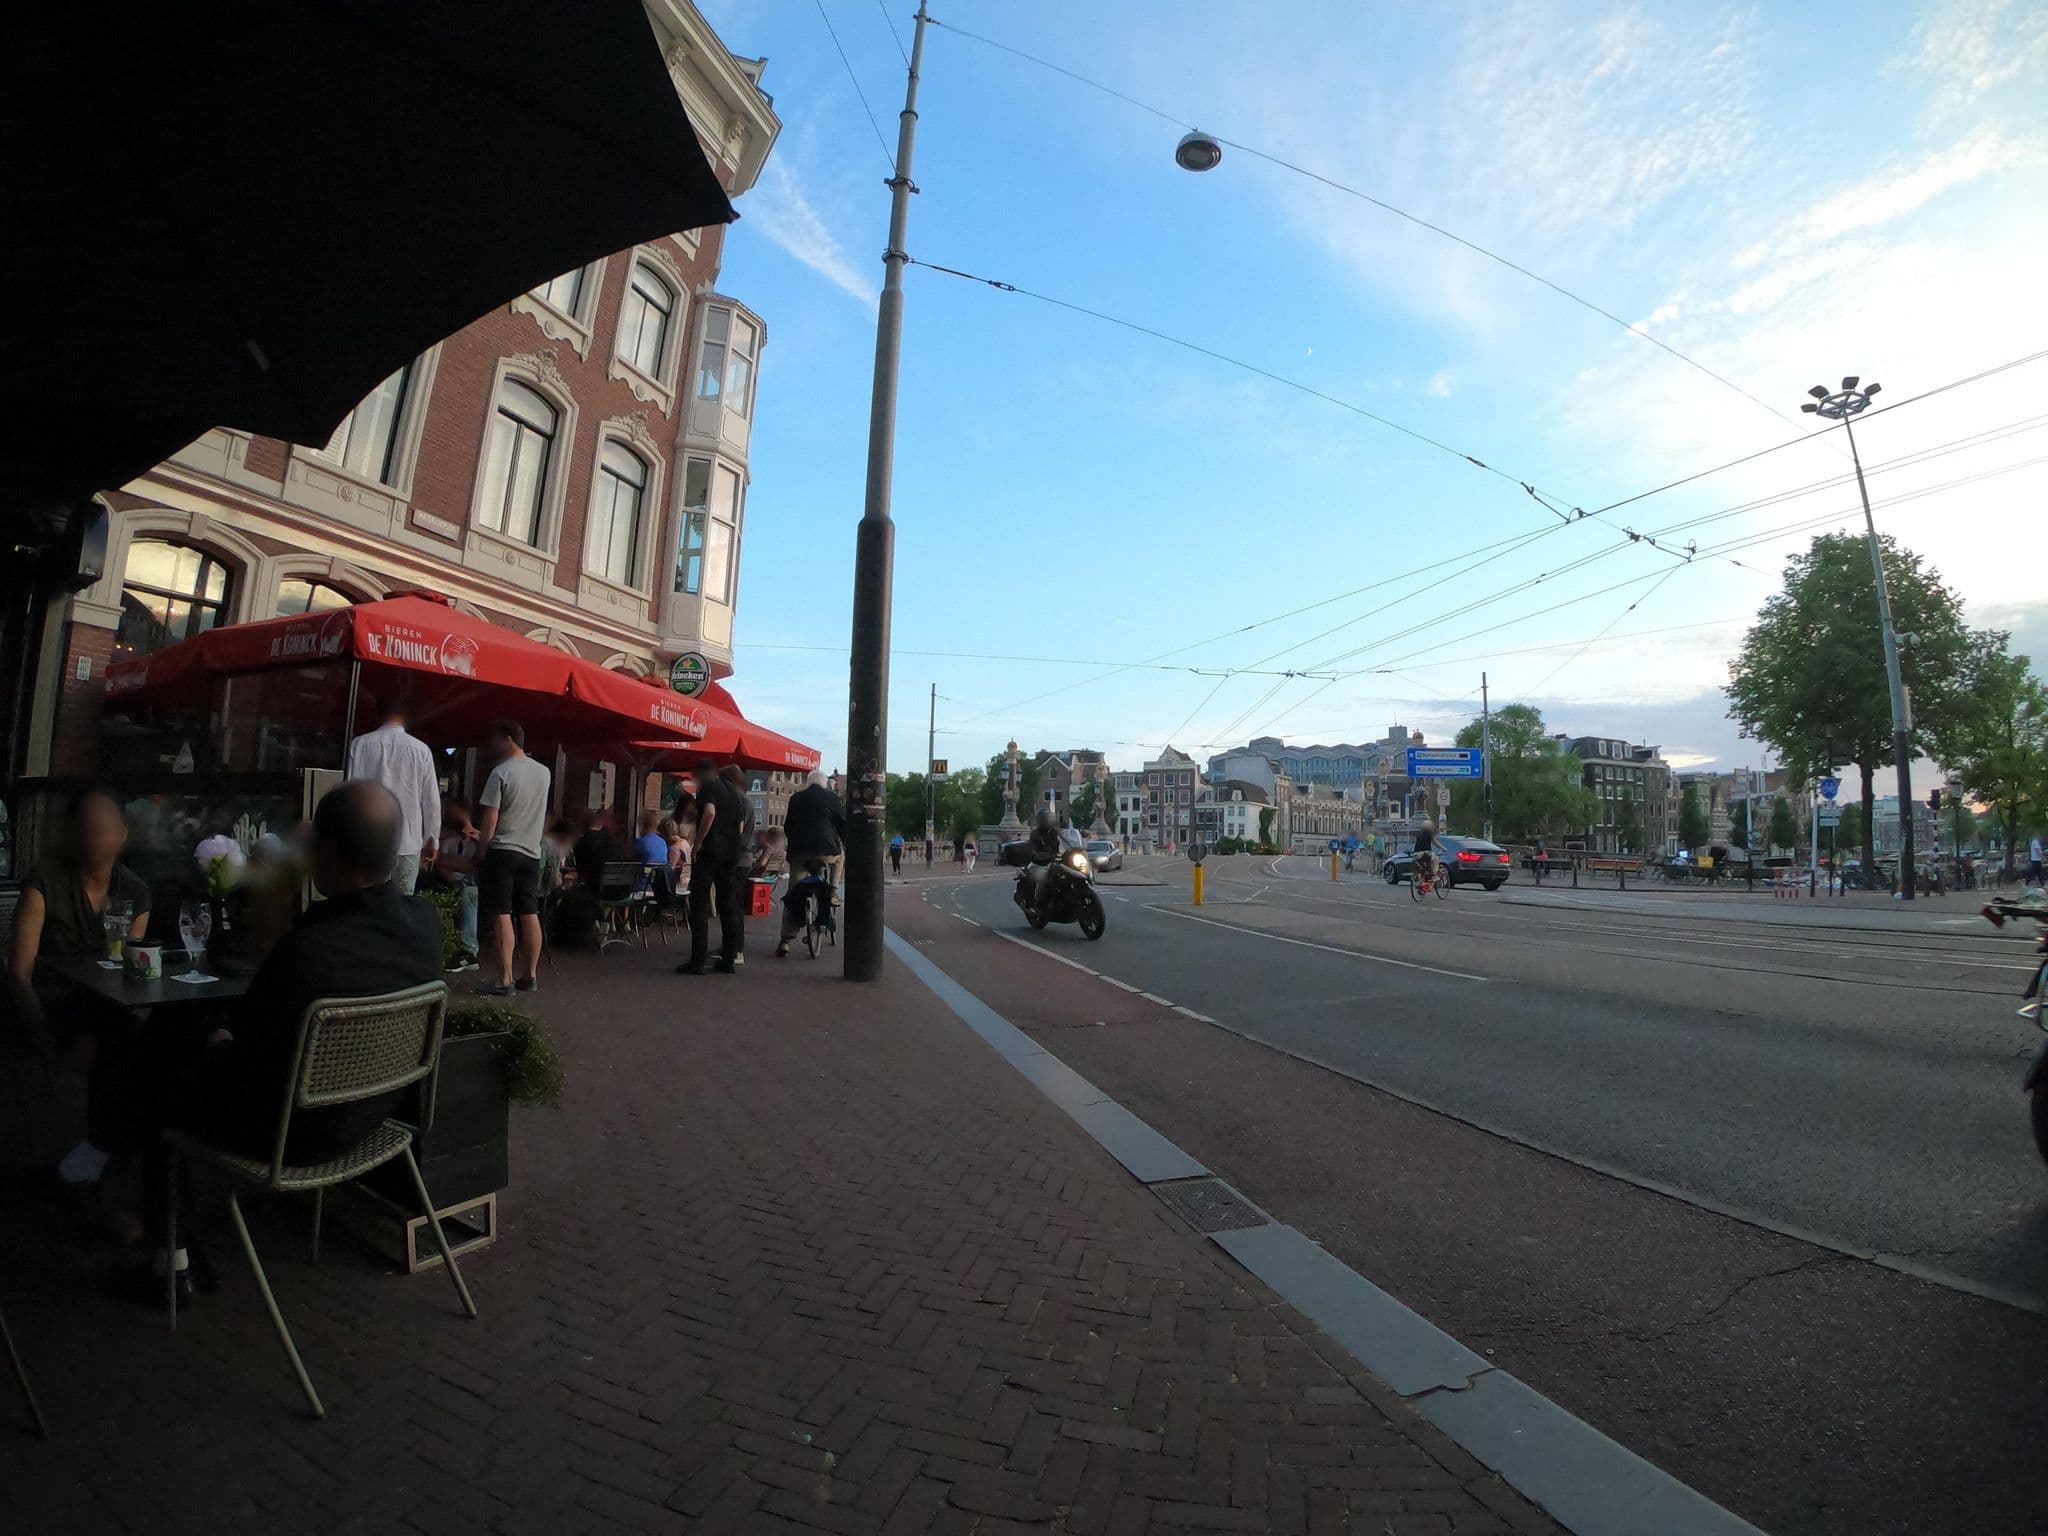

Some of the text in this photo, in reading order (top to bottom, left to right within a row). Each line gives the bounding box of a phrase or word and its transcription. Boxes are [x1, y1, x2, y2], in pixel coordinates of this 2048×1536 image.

[384, 624, 422, 640] BIEREN
[367, 632, 438, 667] DE KONINCK
[651, 703, 660, 721] DE
